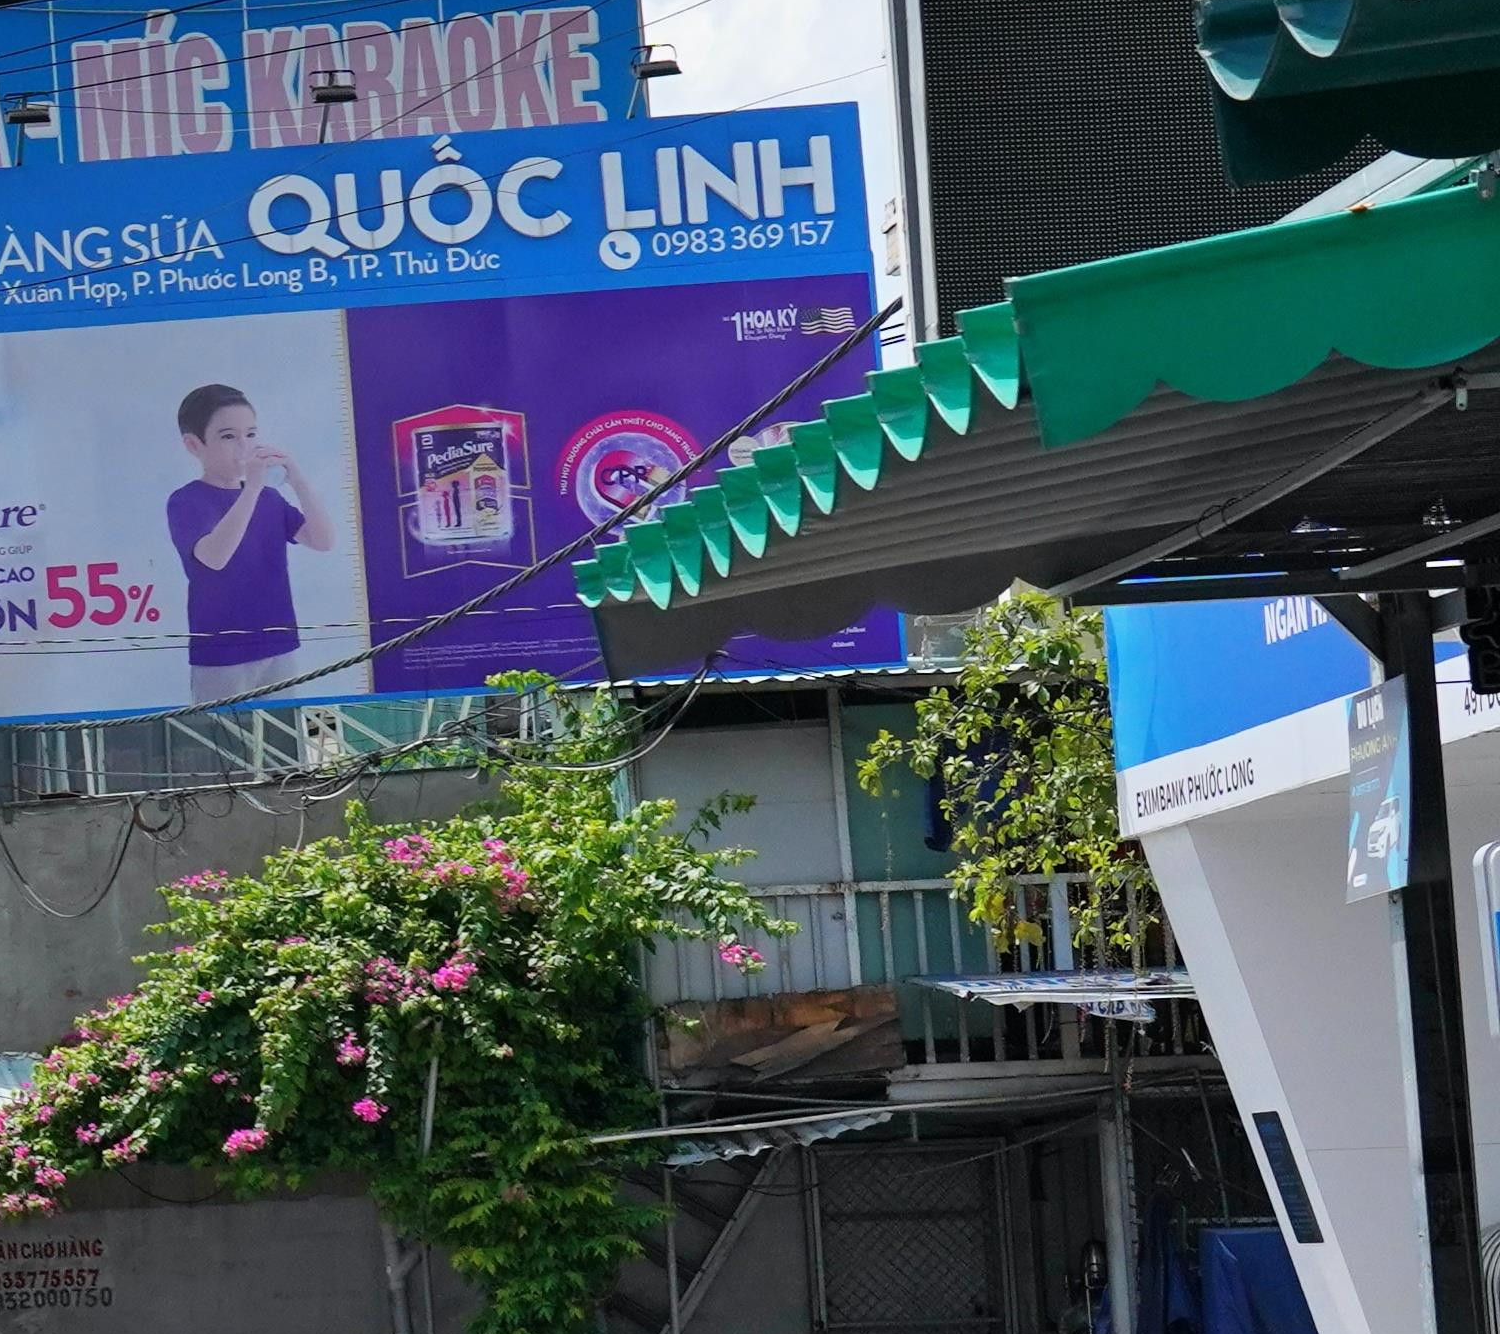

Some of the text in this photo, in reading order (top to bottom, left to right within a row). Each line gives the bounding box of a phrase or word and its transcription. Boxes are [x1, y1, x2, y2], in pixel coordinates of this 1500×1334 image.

[70, 8, 232, 163] MÍC
[243, 5, 608, 151] KARAOKE
[247, 134, 836, 259] QUỐC LINH
[122, 215, 225, 266] SỮA
[652, 220, 835, 257] 0983 369 157
[3, 278, 63, 309] Xuân
[68, 271, 128, 309] Hợp,
[134, 270, 154, 297] P.
[160, 263, 237, 295] Phước
[242, 261, 303, 295] Long
[310, 261, 337, 289] B,
[343, 254, 382, 282] TP.
[390, 248, 440, 275] Thủ
[445, 245, 501, 273] Đức
[7, 543, 33, 556] GIÚP
[45, 561, 161, 630] 55%
[1135, 758, 1255, 818] EXIMBANK PHƯỚC LONG
[57, 1234, 104, 1259] HÀNG
